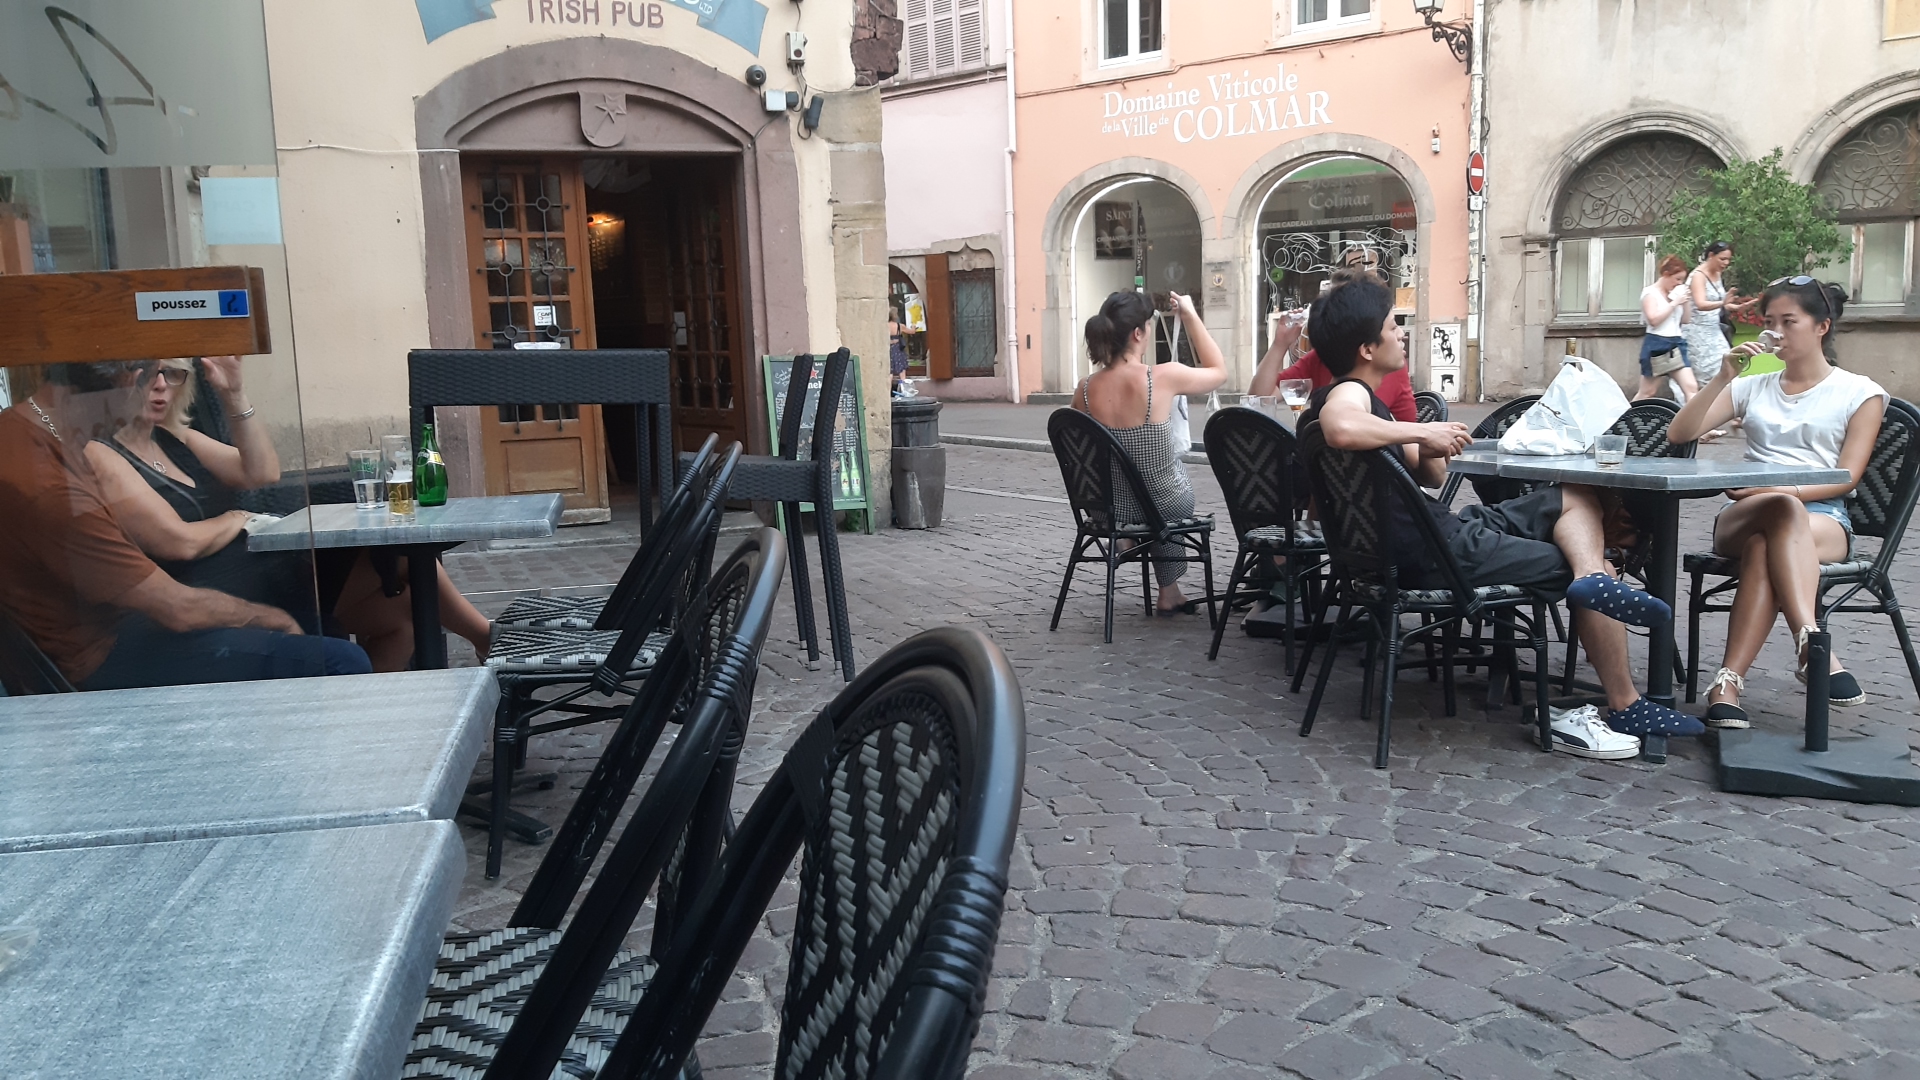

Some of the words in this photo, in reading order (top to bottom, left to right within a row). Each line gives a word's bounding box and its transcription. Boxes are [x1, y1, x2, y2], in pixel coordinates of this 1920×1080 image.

[528, 0, 600, 25] IRISH
[612, 1, 664, 28] PUB
[1103, 82, 1200, 118] Domaine
[1207, 63, 1298, 101] Viticole
[1102, 121, 1112, 133] de
[1113, 120, 1121, 132] la
[1120, 114, 1158, 138] Ville
[1159, 113, 1169, 125] de
[1173, 91, 1334, 143] COLMAR
[1308, 192, 1371, 209] Colmar
[1282, 220, 1313, 228] CADEAUX
[1375, 213, 1385, 221] DU
[152, 299, 207, 312] poussez
